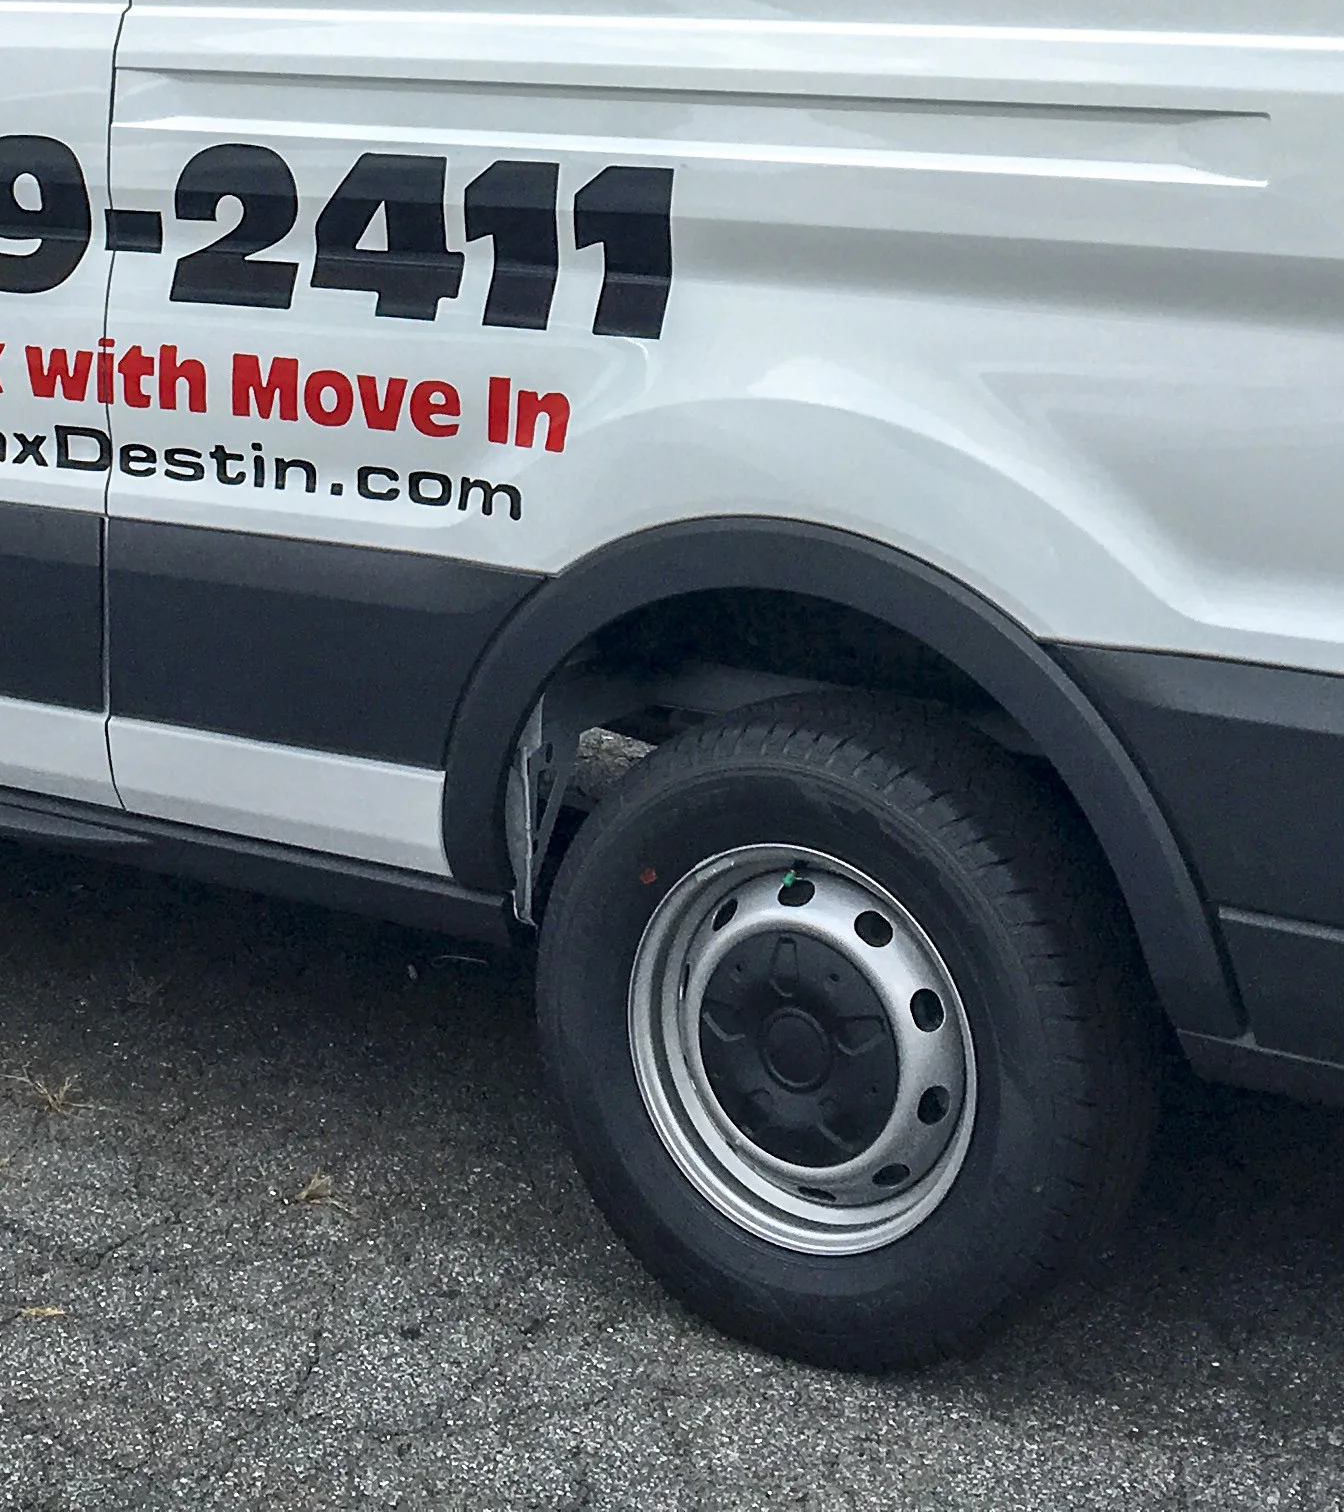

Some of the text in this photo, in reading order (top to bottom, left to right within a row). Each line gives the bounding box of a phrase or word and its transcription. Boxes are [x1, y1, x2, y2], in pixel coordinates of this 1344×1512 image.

[24, 338, 207, 413] with
[232, 353, 461, 437] Move
[488, 376, 571, 453] In
